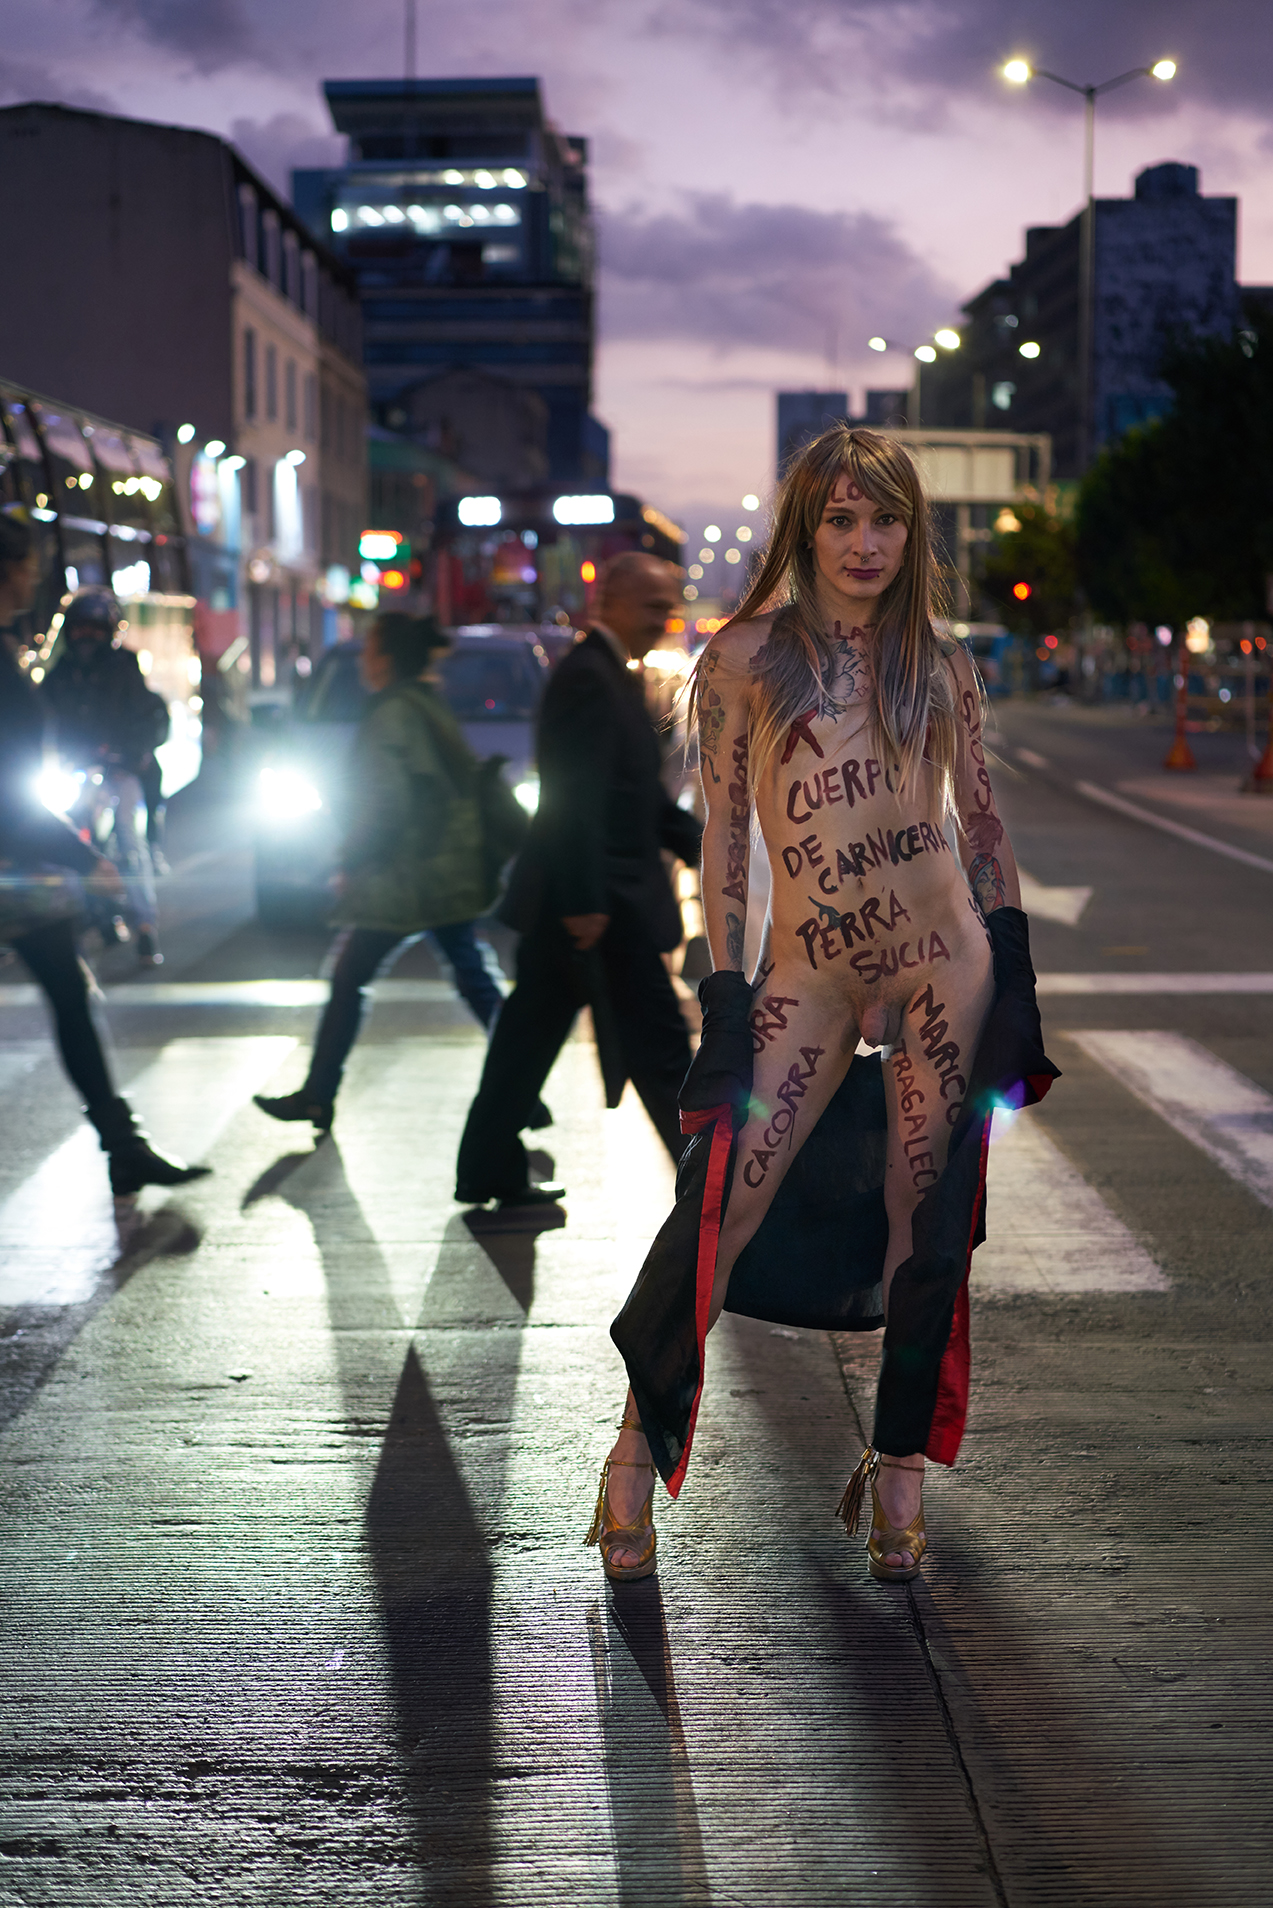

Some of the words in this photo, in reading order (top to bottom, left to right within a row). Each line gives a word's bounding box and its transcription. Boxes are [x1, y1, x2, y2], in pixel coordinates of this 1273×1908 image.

[830, 479, 873, 503] LO
[782, 834, 825, 879] DE
[818, 821, 951, 895] CARNICERIA
[795, 889, 911, 970] PERRA
[849, 930, 950, 985] SUCIA
[743, 1045, 826, 1188] CACORRA
